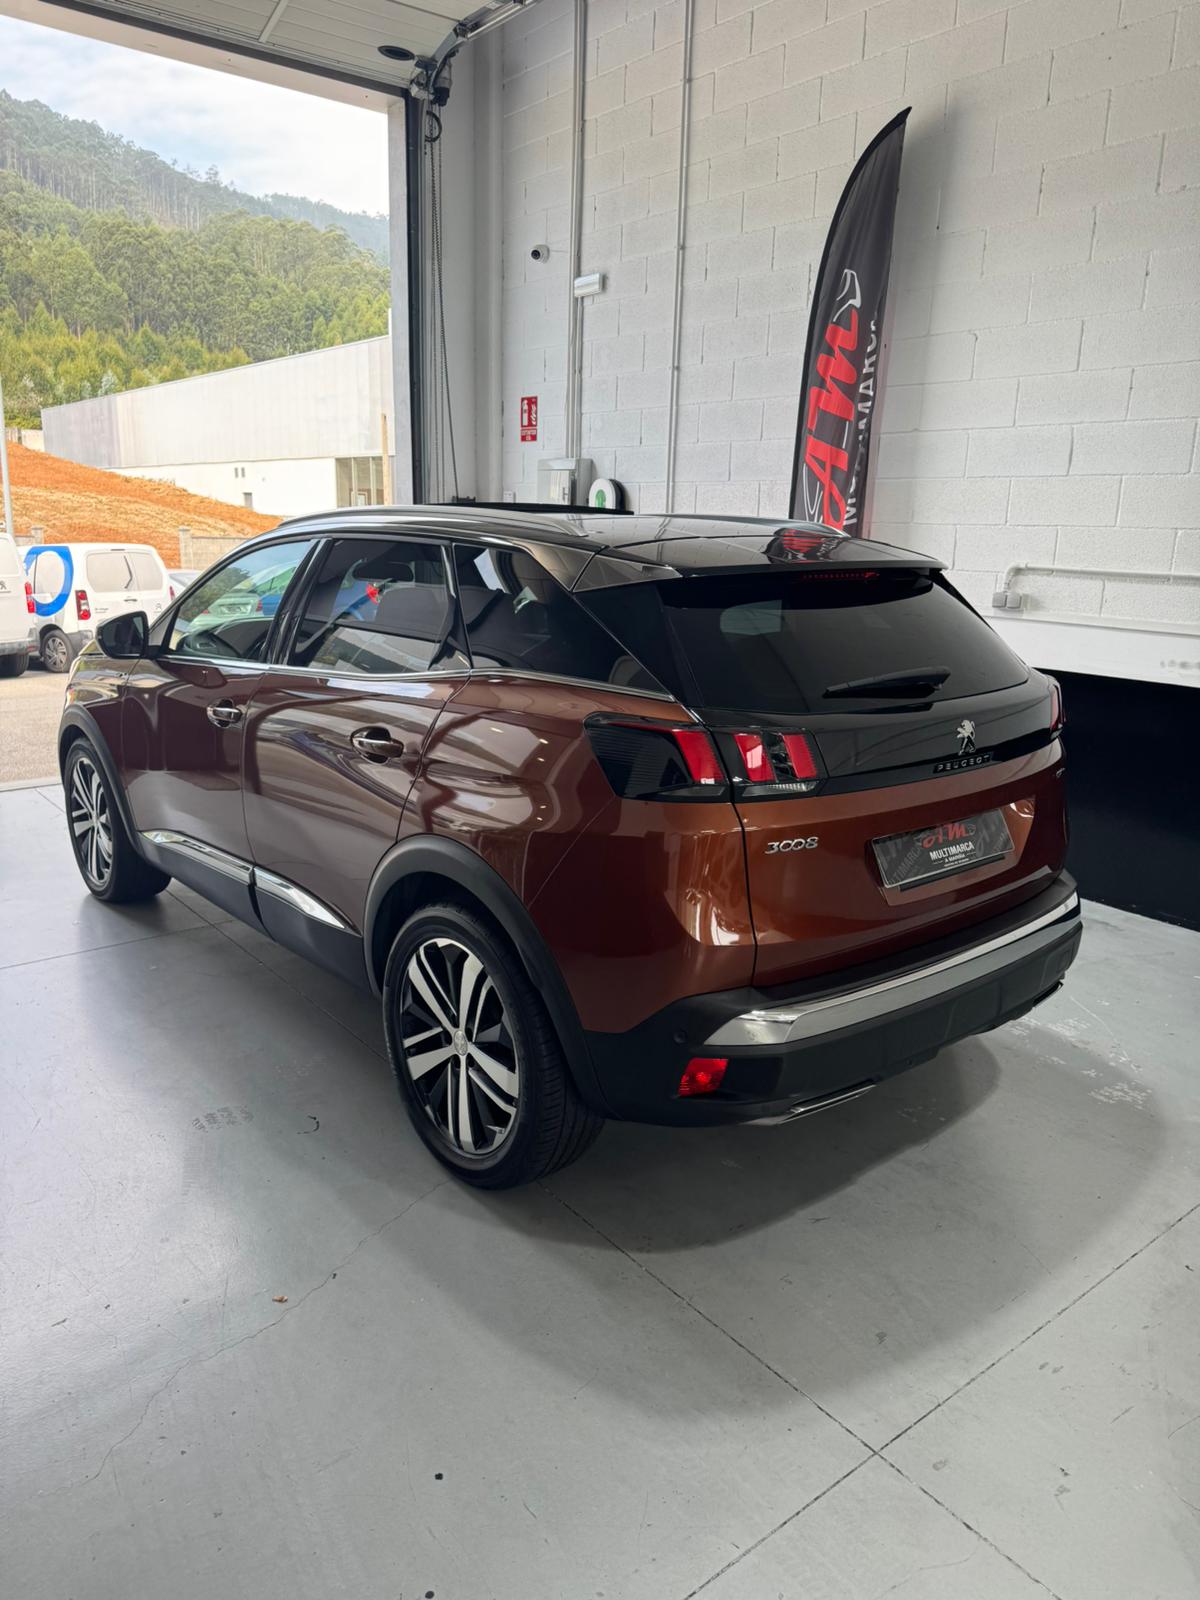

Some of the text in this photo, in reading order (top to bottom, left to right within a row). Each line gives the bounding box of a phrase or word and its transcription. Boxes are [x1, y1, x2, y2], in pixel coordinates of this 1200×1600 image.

[937, 754, 990, 771] PEUGEOT
[764, 836, 819, 854] 3008
[929, 841, 975, 861] MULTIMARCA
